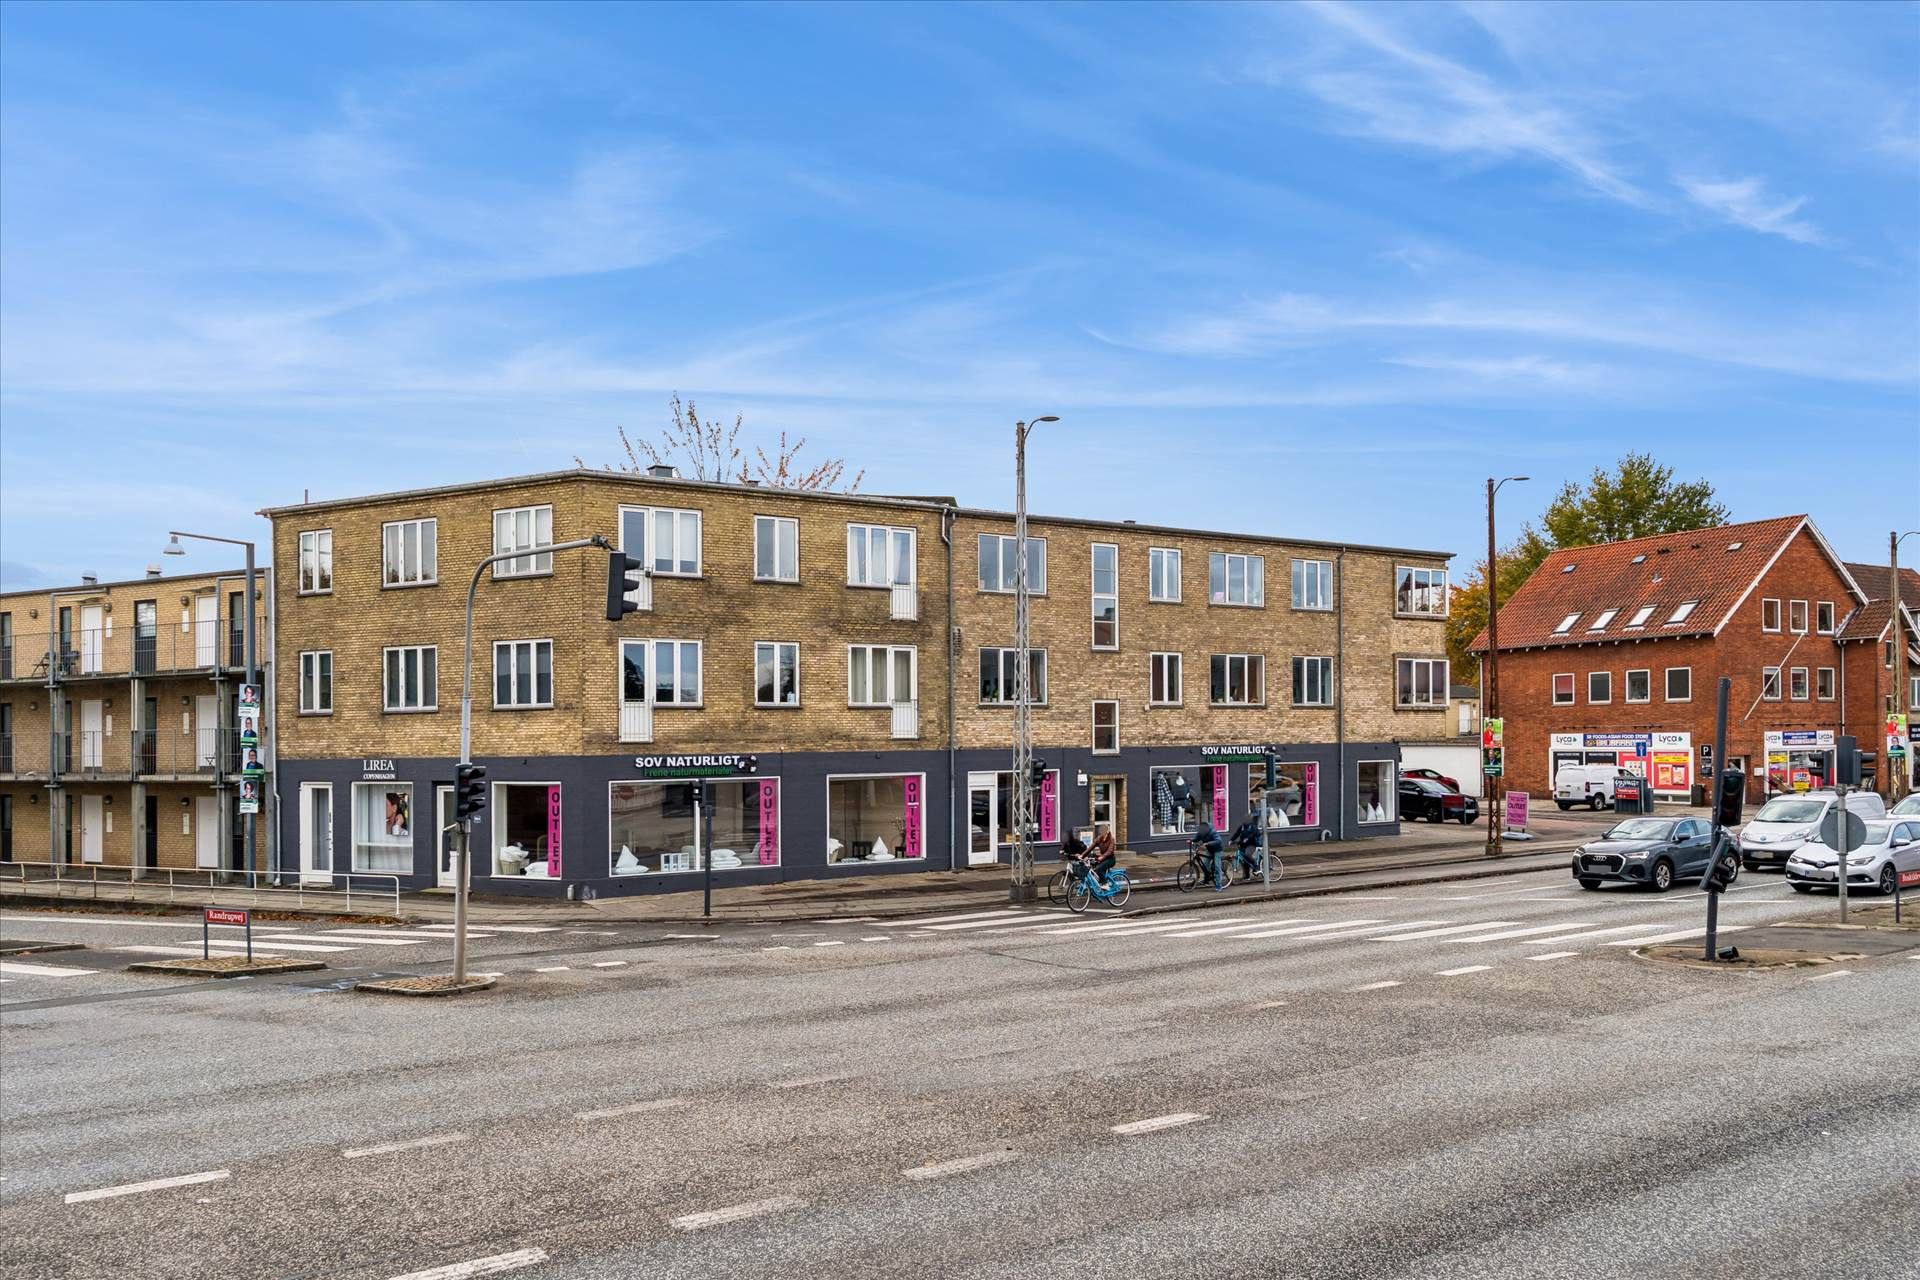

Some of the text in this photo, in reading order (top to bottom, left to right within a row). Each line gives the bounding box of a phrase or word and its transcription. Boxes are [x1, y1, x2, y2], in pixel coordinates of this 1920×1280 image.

[1658, 734, 1677, 743] Lyca
[1201, 745, 1266, 755] SOV NATURLIGT
[1703, 746, 1709, 755] P
[363, 759, 395, 771] LIREA
[635, 755, 740, 768] SOV NATURLIGT
[763, 786, 773, 860] OUTLET
[907, 782, 917, 851] OUTLET
[551, 792, 561, 871] OUTLET
[209, 910, 244, 923] Randrupvej
